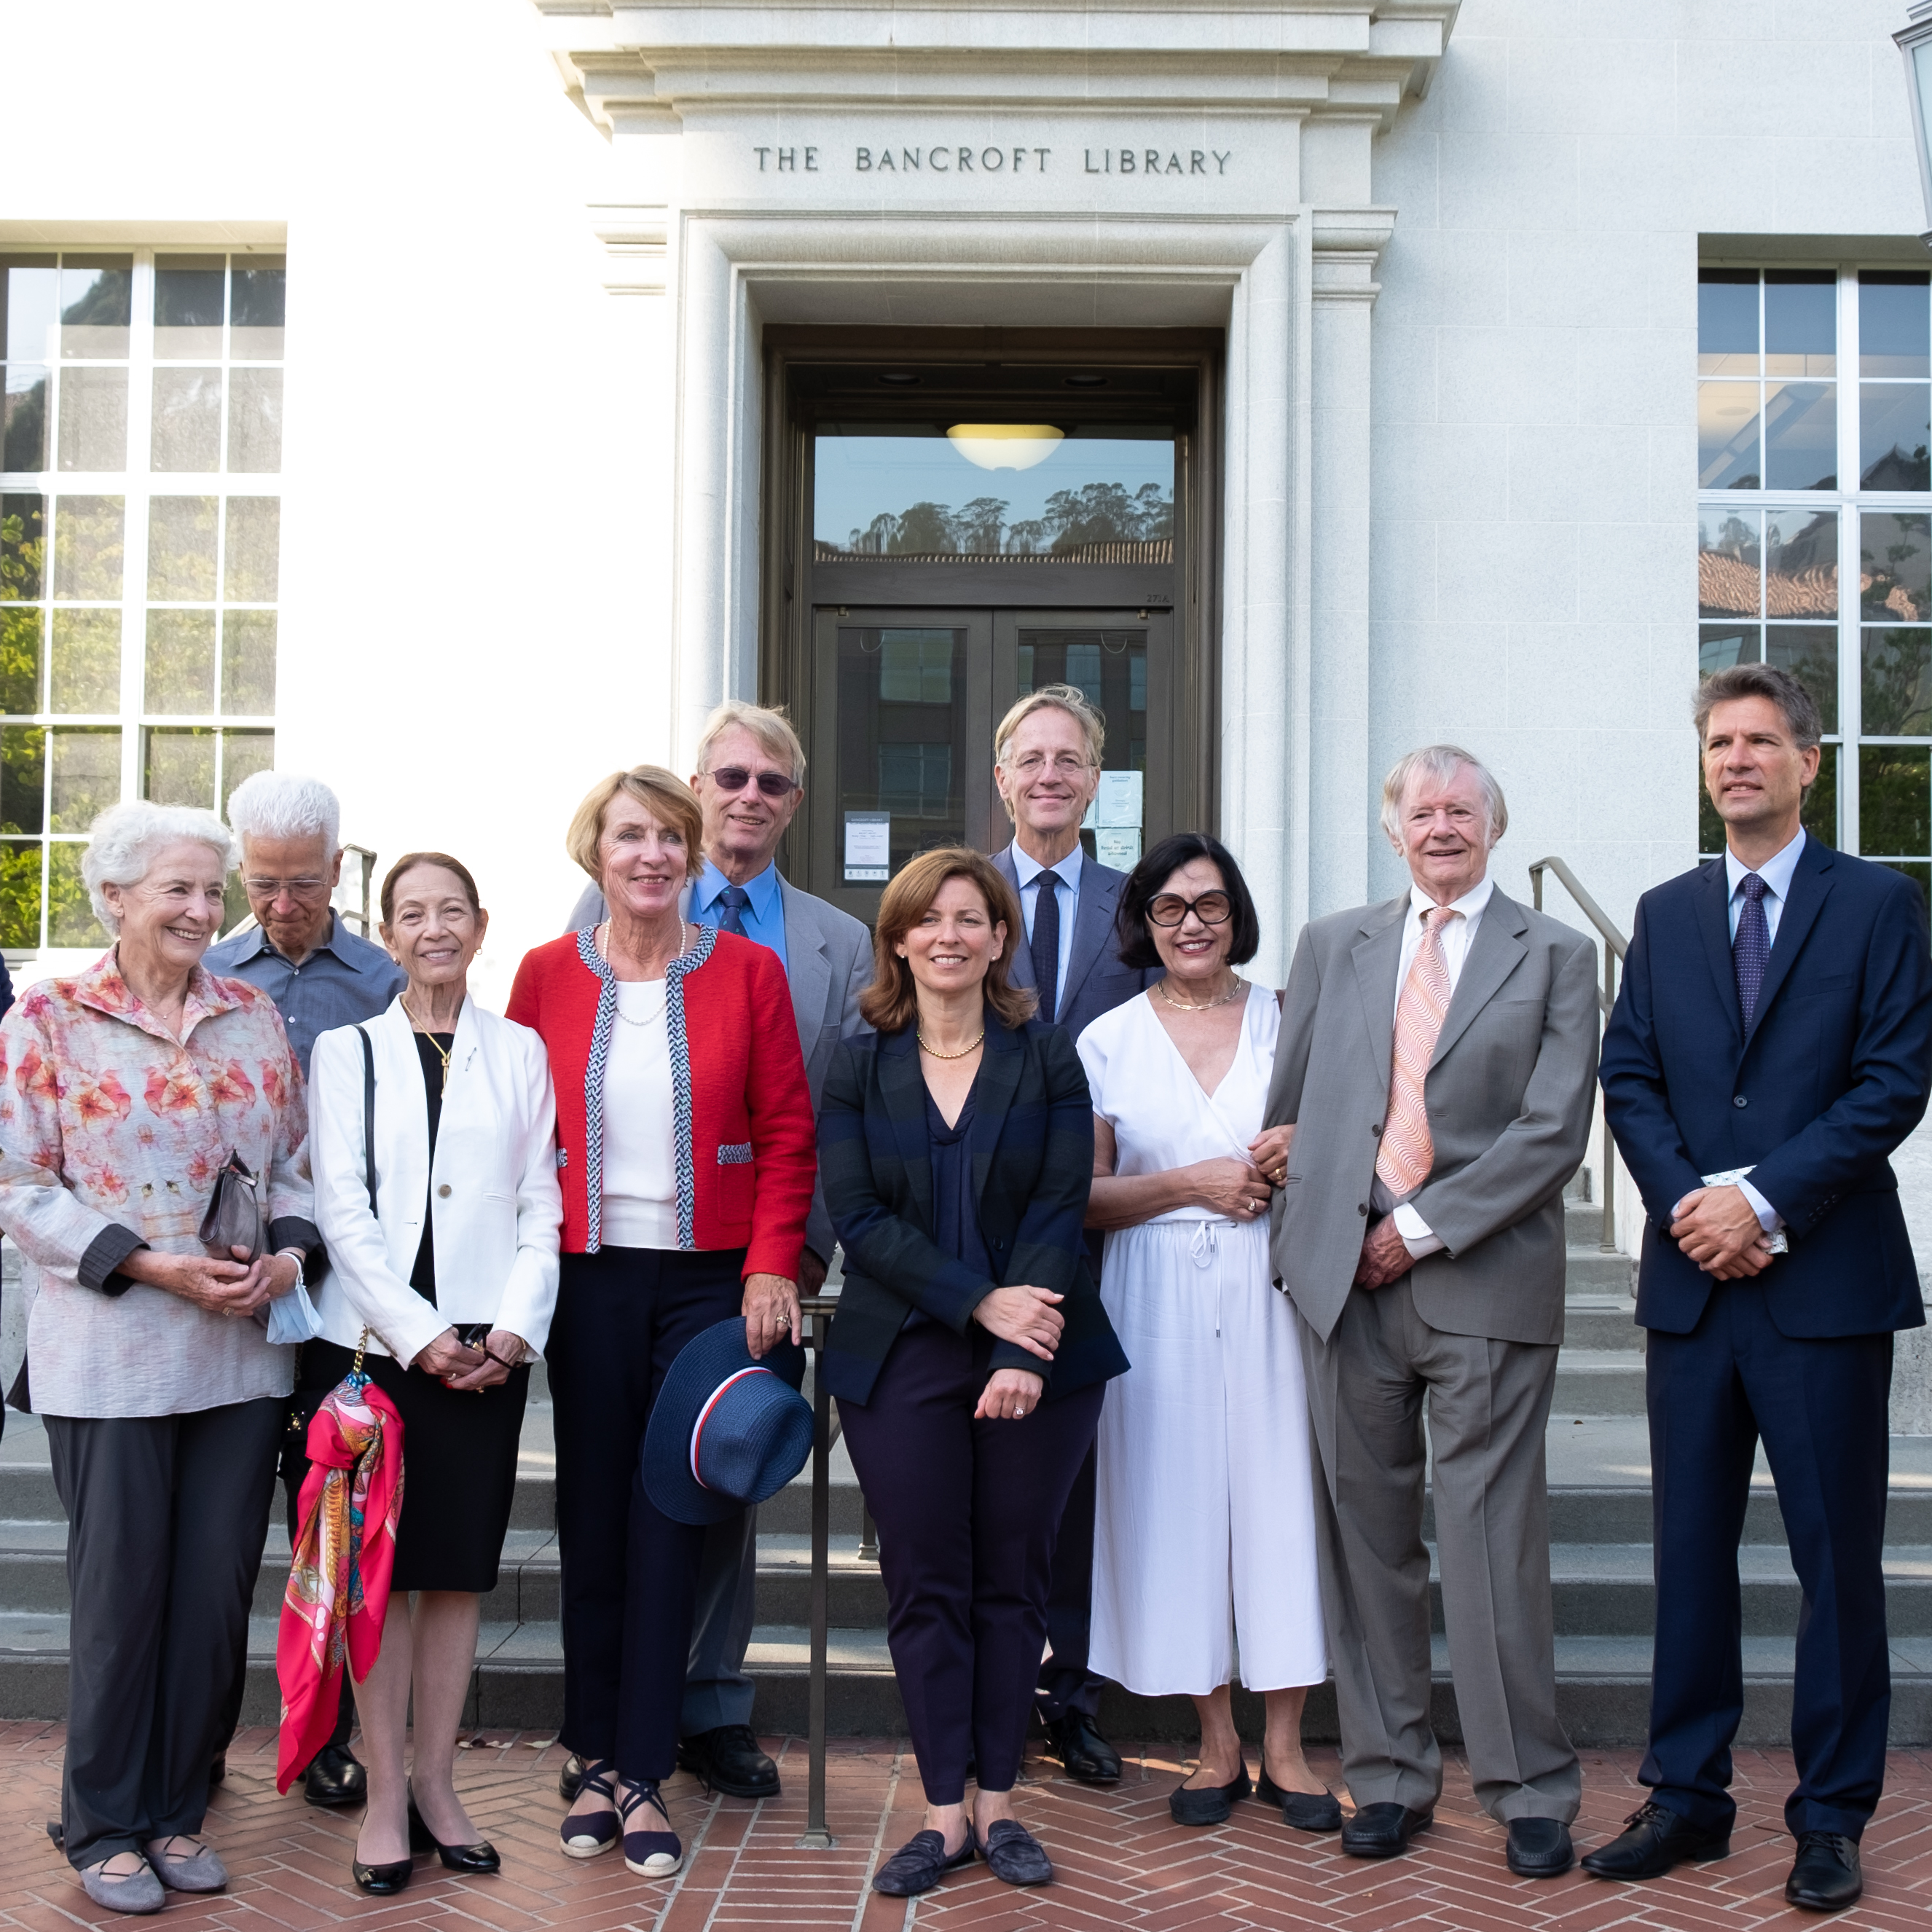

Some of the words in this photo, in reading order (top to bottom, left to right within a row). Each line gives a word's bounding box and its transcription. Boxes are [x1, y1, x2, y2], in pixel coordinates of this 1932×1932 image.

[753, 146, 818, 171] THE
[855, 146, 1051, 173] BANCROFT
[1084, 148, 1231, 175] LIBRARY
